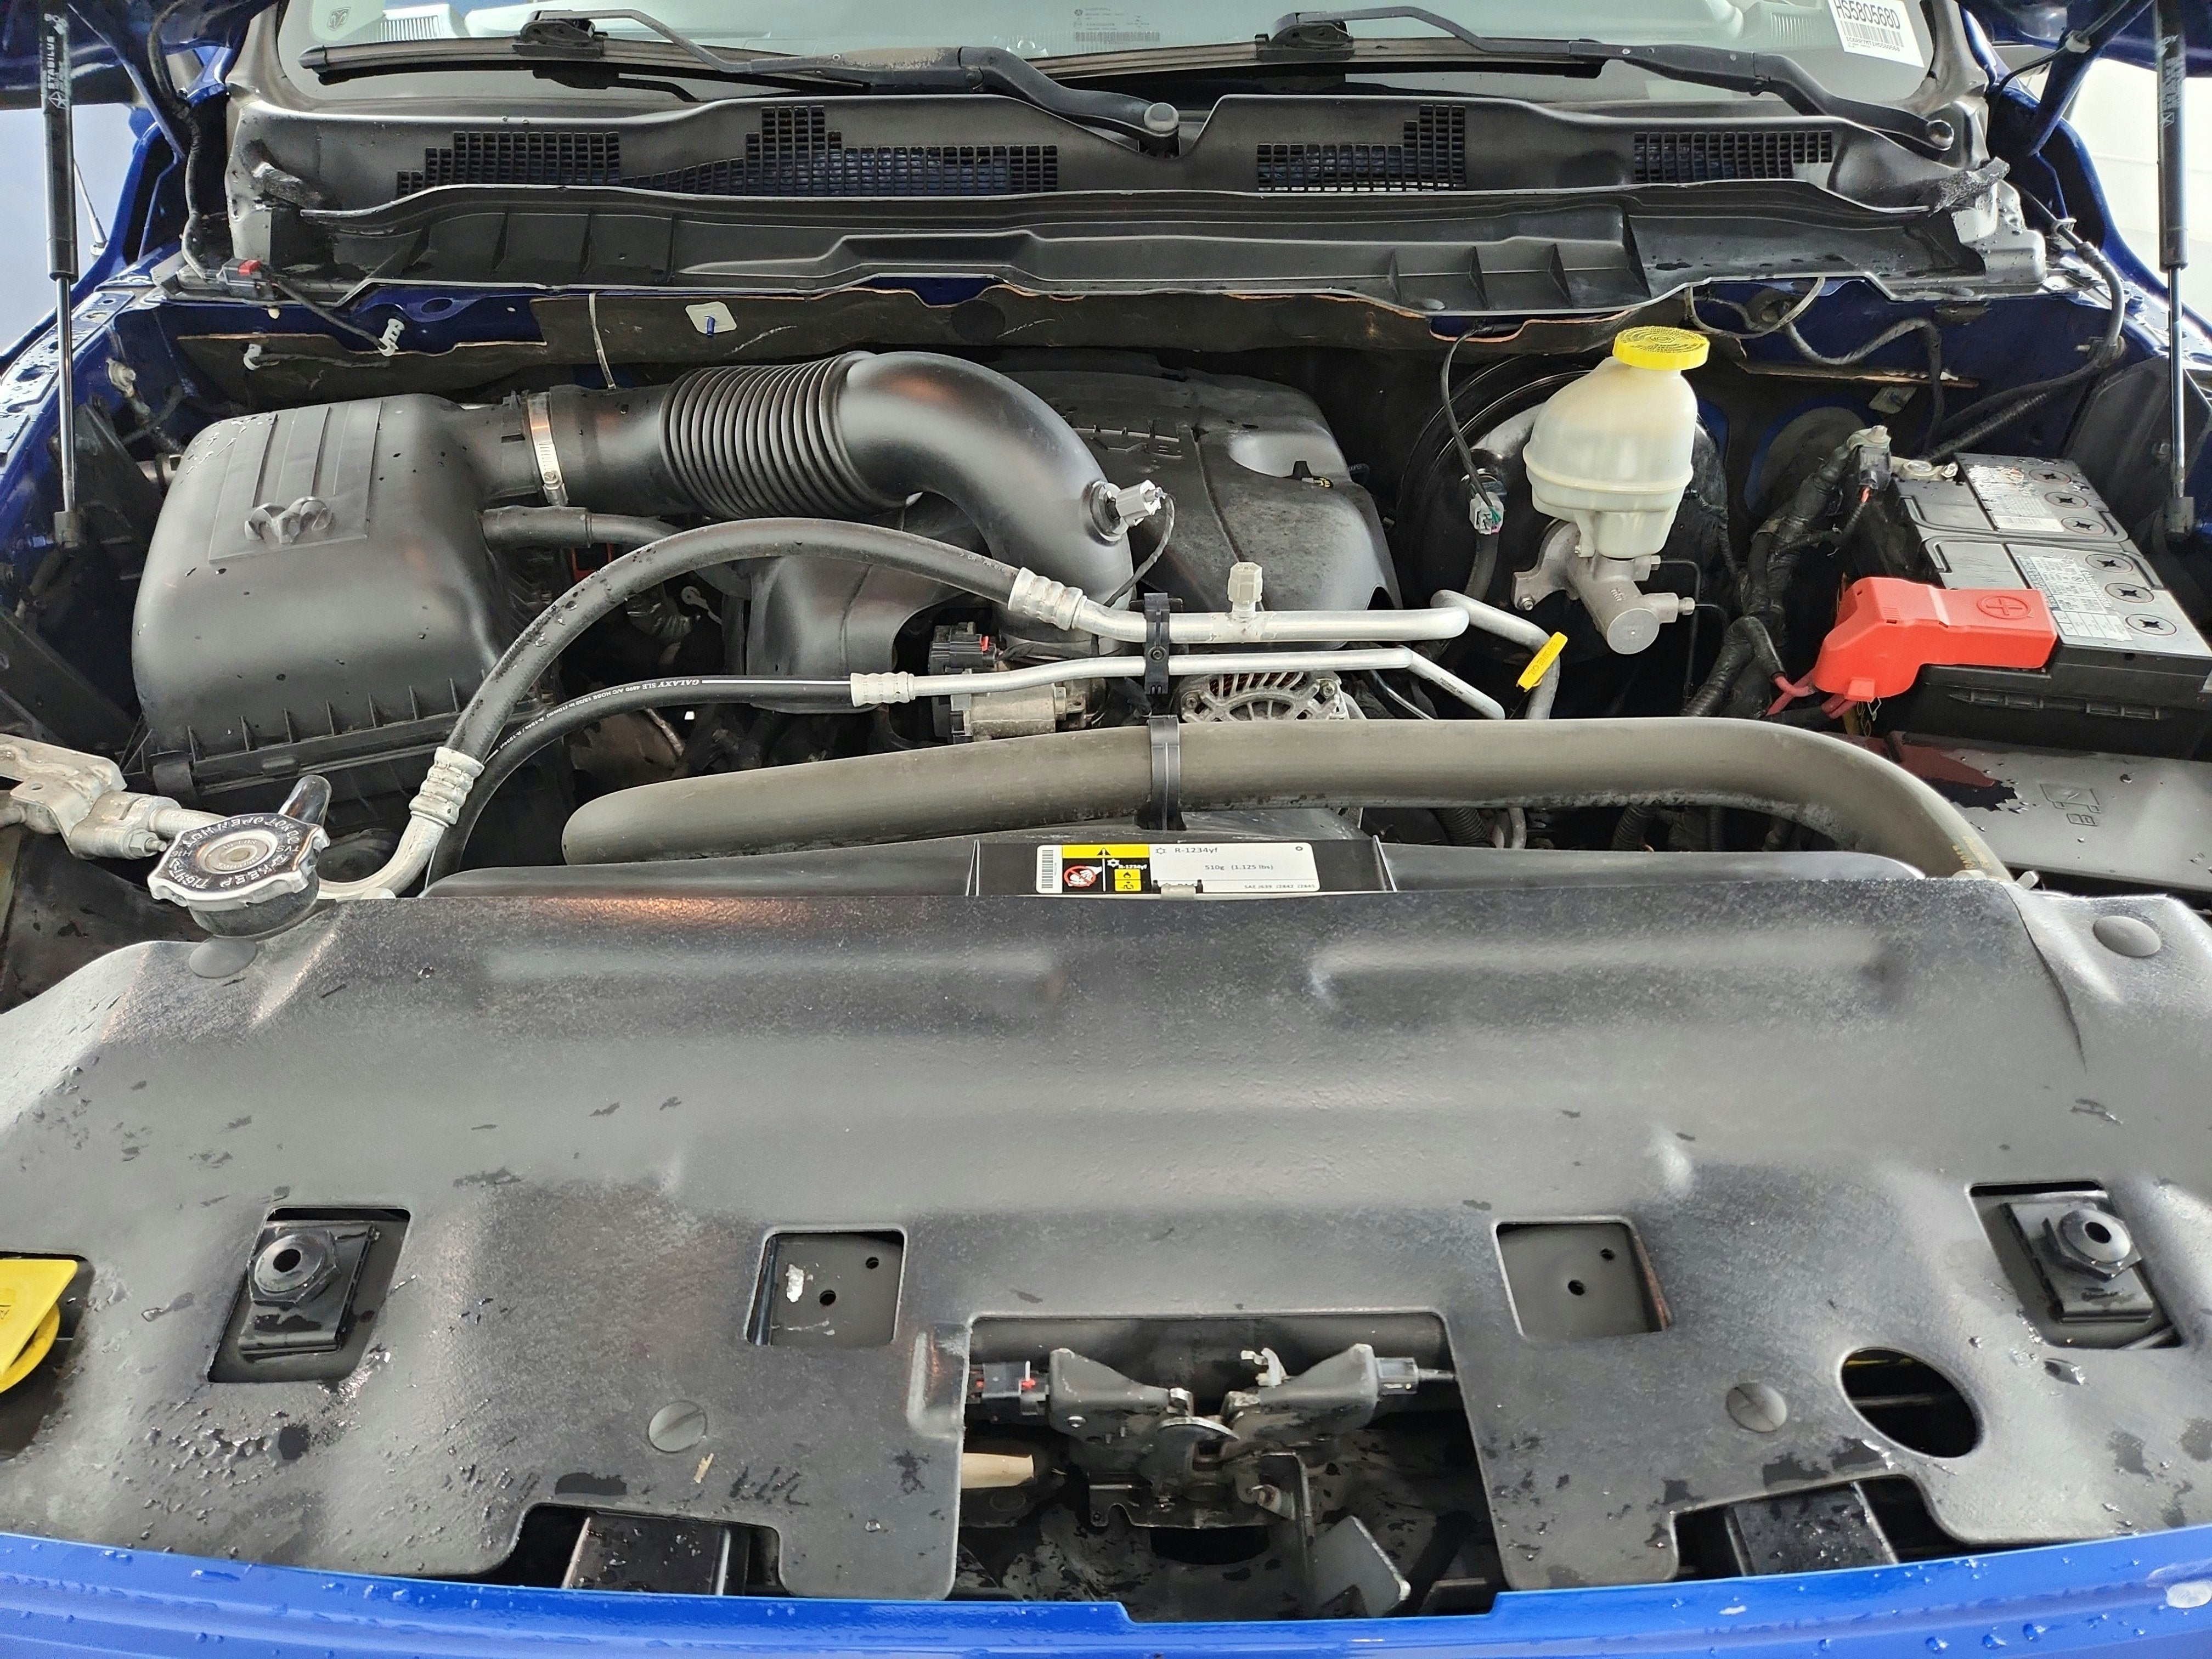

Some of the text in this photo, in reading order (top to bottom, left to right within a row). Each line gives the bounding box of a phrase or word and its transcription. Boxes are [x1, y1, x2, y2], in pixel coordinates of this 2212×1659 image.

[1833, 0, 1900, 30] HS580568D
[657, 679, 699, 687] GALAXY
[575, 697, 592, 706] 13/32
[592, 690, 611, 700] HOSE
[546, 705, 568, 718] (10mm)
[218, 816, 264, 831] OPEN
[220, 864, 273, 888] KEEP
